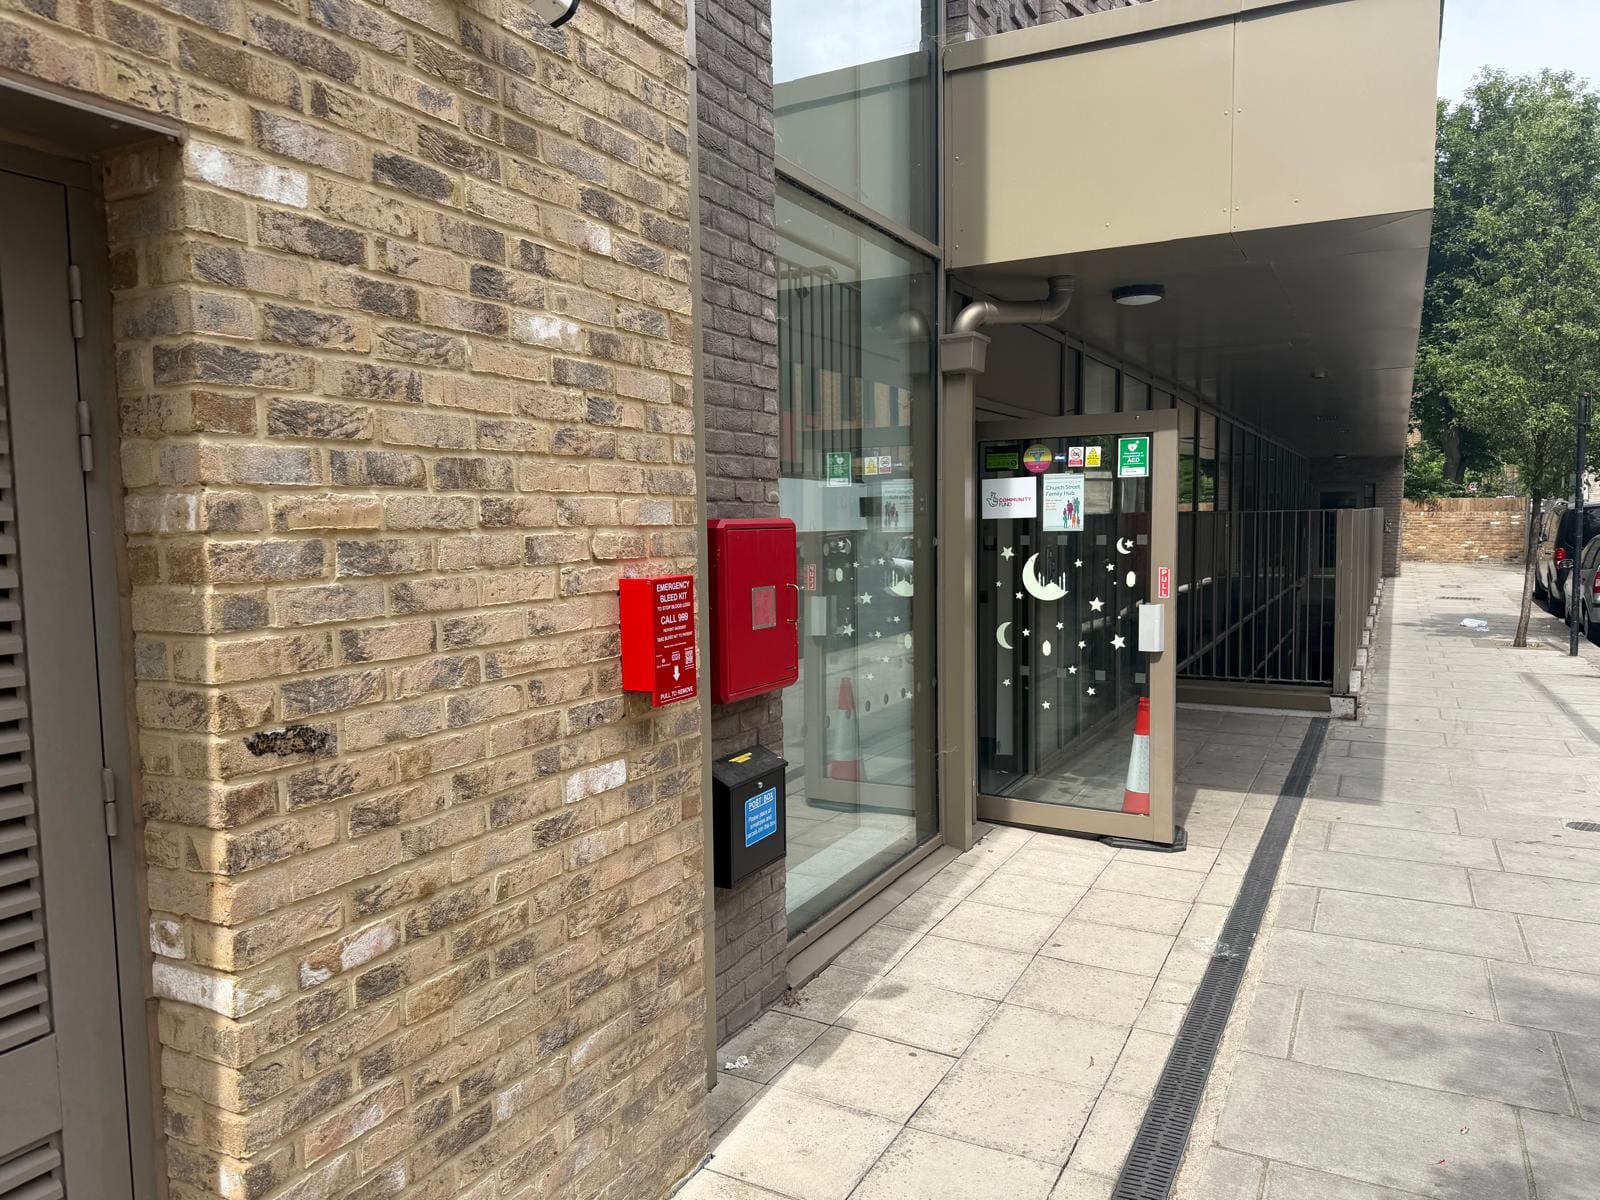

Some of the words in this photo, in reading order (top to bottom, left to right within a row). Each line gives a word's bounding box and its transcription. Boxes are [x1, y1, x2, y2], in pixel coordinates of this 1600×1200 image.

[656, 580, 690, 592] EMERGENCY
[660, 594, 678, 602] BLEED
[679, 592, 688, 600] KIT
[661, 614, 677, 625] CALL
[678, 612, 688, 622] 999
[660, 692, 671, 700] PULL
[678, 686, 694, 694] REMOVE
[749, 797, 762, 810] POST
[764, 792, 774, 802] BOX
